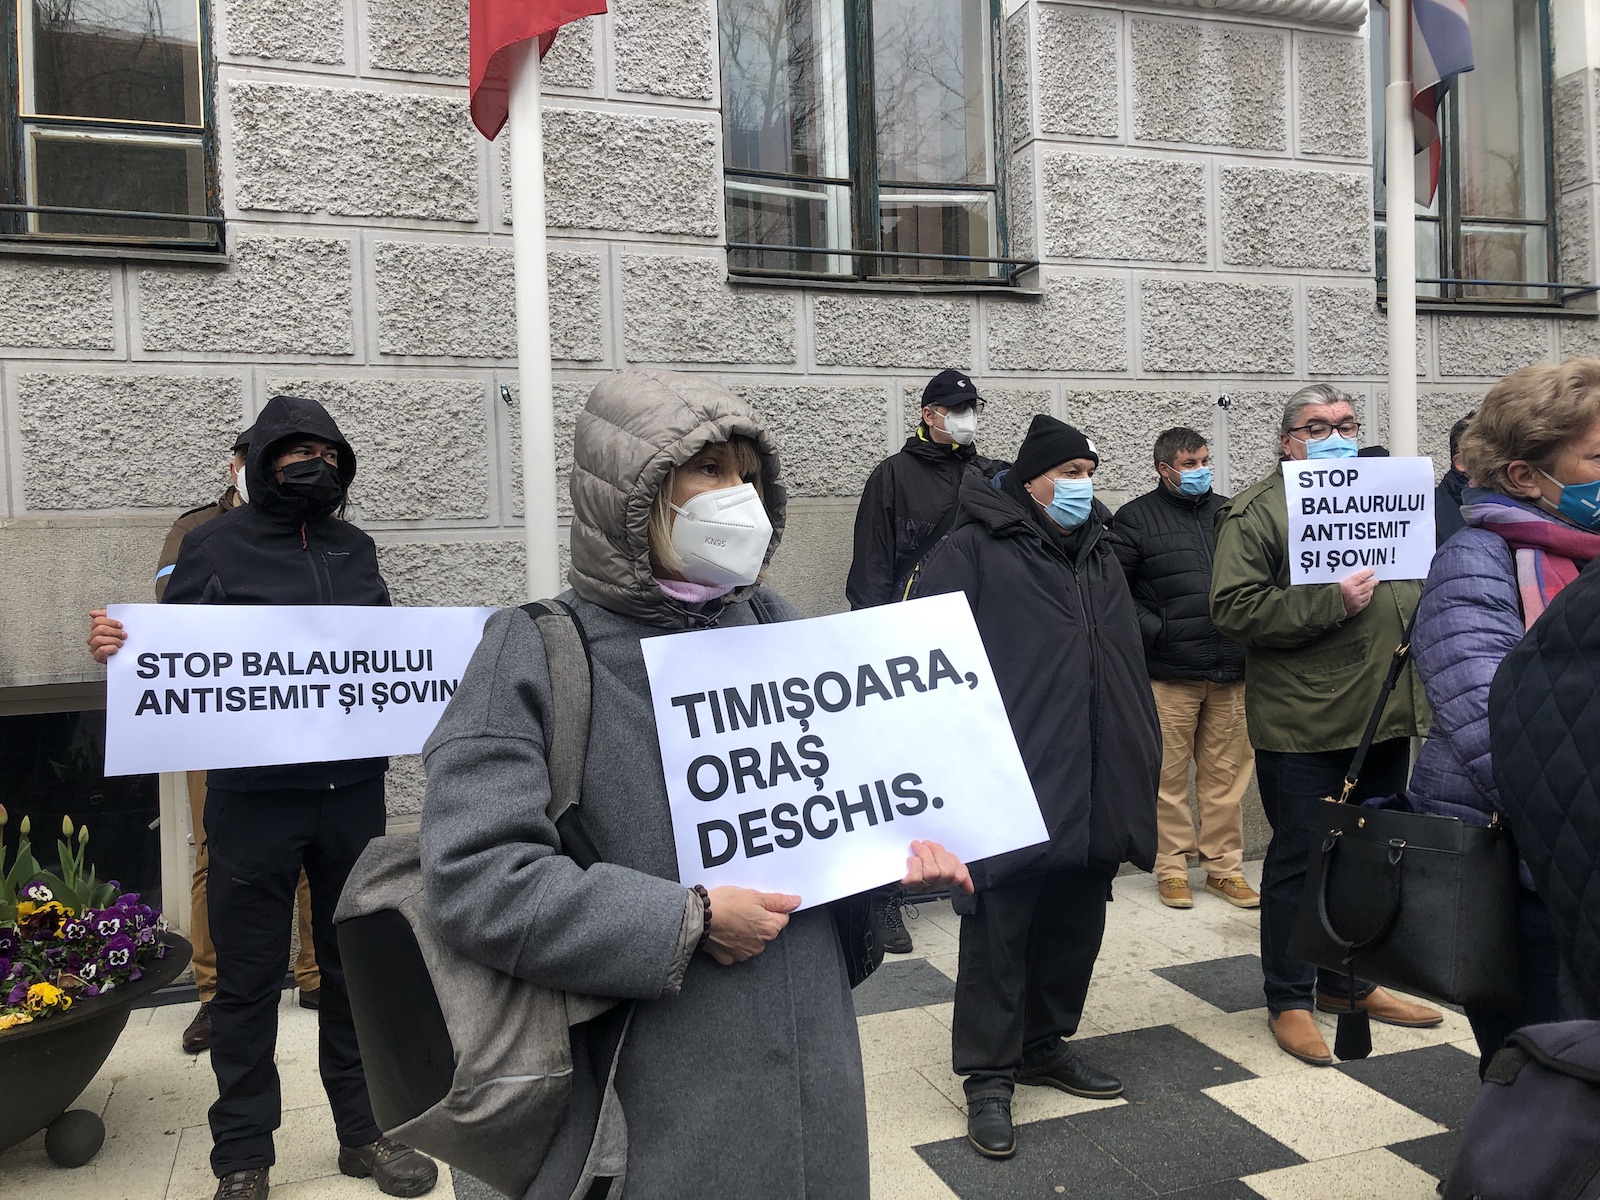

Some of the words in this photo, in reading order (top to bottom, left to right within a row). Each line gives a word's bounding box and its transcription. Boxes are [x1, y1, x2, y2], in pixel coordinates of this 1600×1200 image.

[1299, 469, 1359, 488] STOP
[1301, 494, 1425, 515] BALAURULUI
[1300, 521, 1411, 542] ANTISEMIT
[1300, 550, 1321, 575] ȘI
[136, 652, 232, 680] STOP
[242, 649, 433, 677] BALAURULUI
[135, 684, 331, 716] ANTISEMIT
[338, 682, 364, 715] ȘI
[671, 648, 979, 739] TIMIȘOARA,
[687, 734, 830, 802] ORAȘ
[696, 772, 944, 870] DESCHIS.
